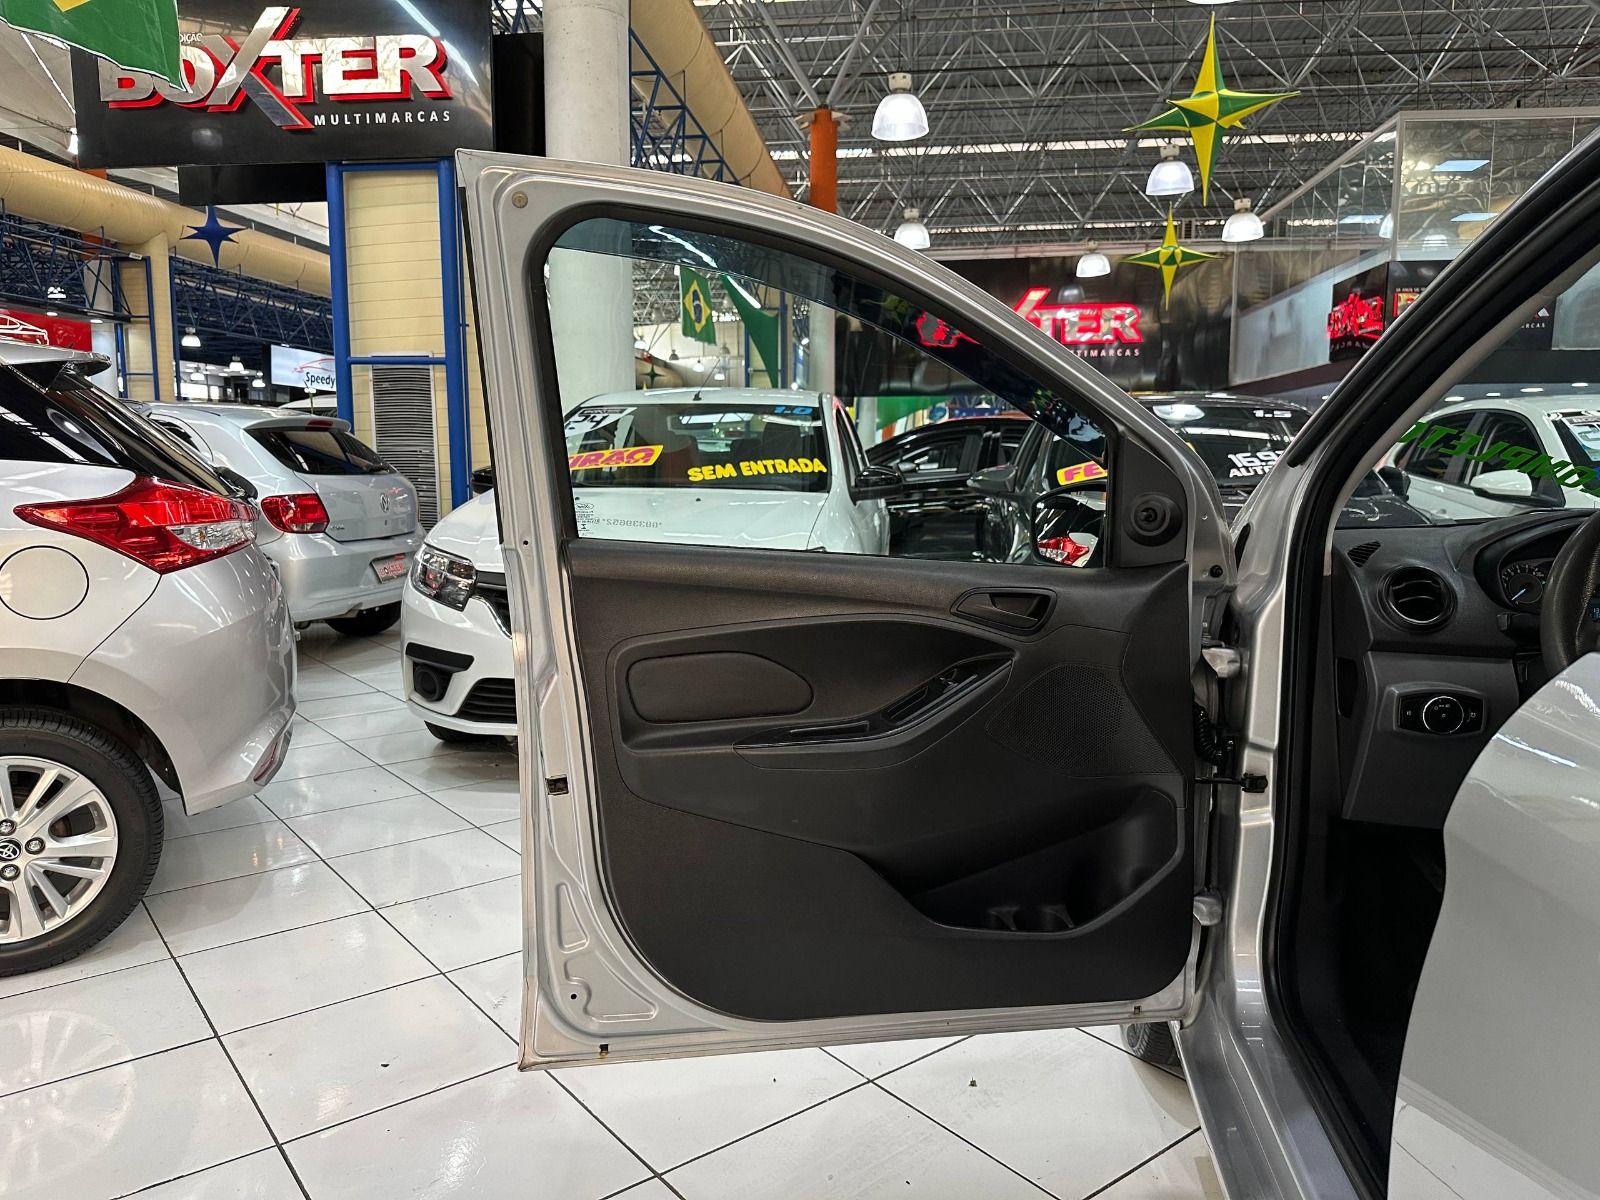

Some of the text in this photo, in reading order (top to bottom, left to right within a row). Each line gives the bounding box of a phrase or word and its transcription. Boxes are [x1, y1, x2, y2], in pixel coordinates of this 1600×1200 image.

[313, 110, 451, 126] MULTIMARCAS
[305, 371, 336, 389] Speedy
[1253, 409, 1292, 418] 1.5
[1227, 450, 1285, 468] 16.9
[687, 458, 827, 482] SEM ENTRADA
